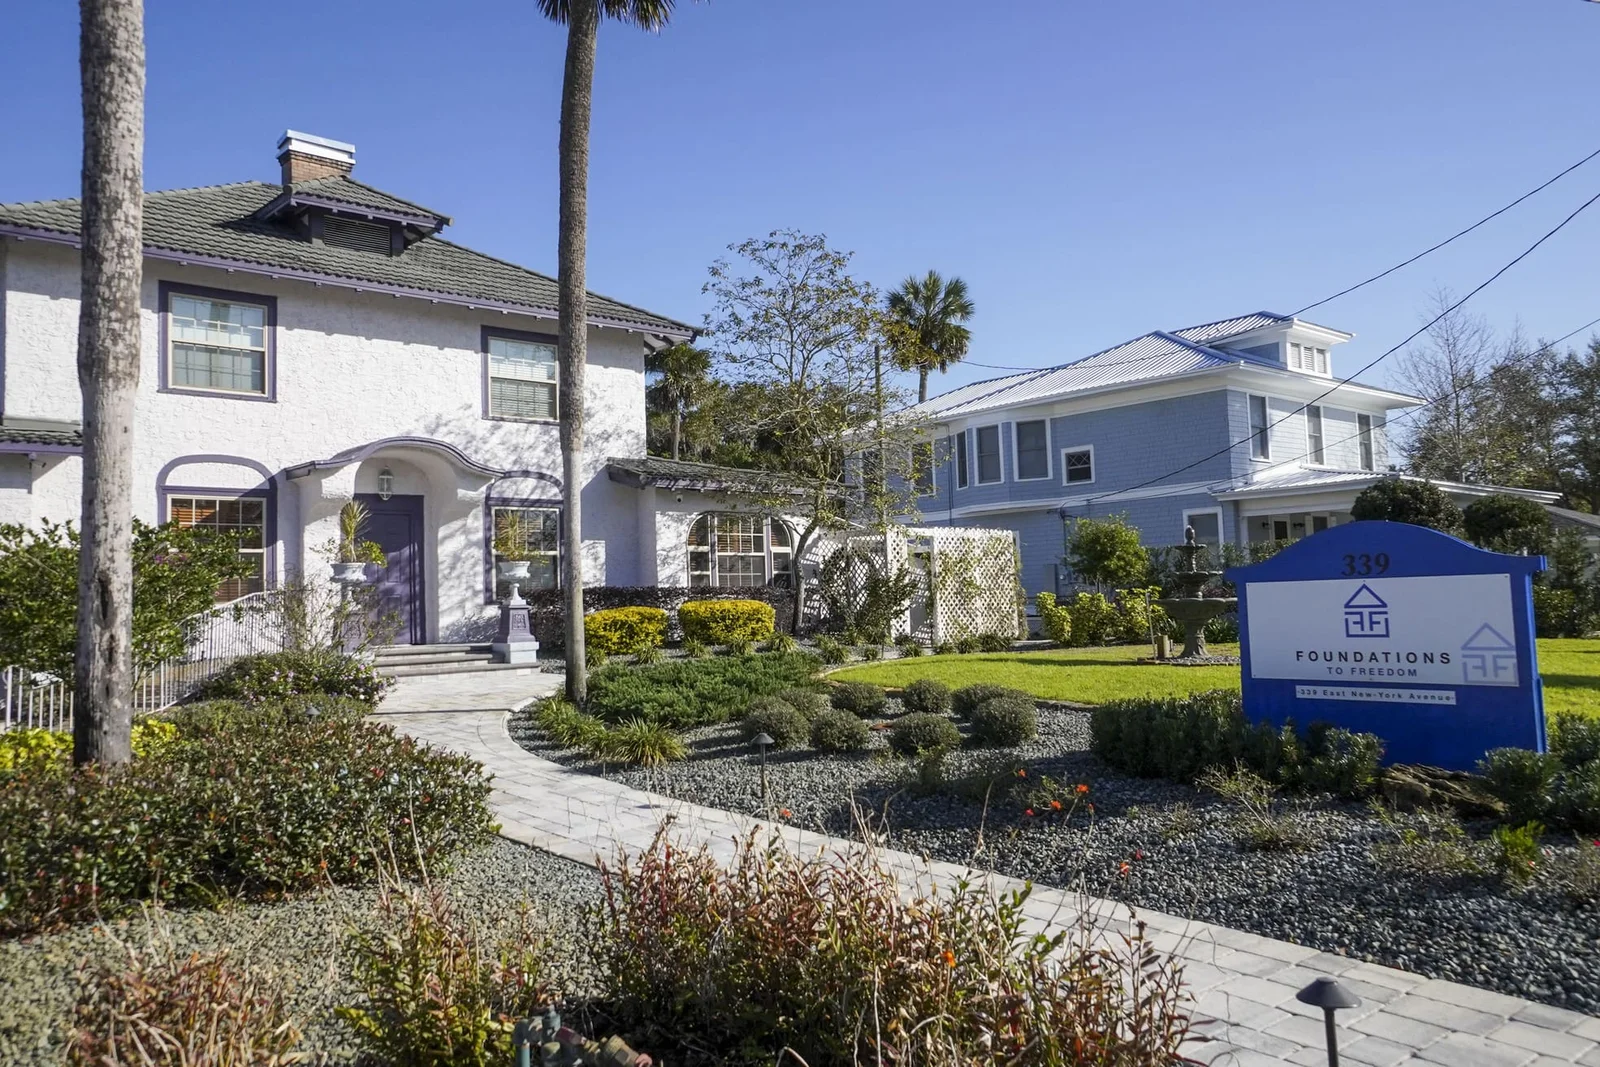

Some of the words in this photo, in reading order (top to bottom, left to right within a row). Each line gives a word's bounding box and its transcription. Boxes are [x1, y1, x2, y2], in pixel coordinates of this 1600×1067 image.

[1341, 553, 1390, 577] 339
[1296, 651, 1451, 664] FOUNDATIONS
[1327, 666, 1343, 675] TO
[1351, 668, 1417, 677] FREEDOM
[1323, 689, 1346, 697] East
[1409, 693, 1451, 701] Avenue
